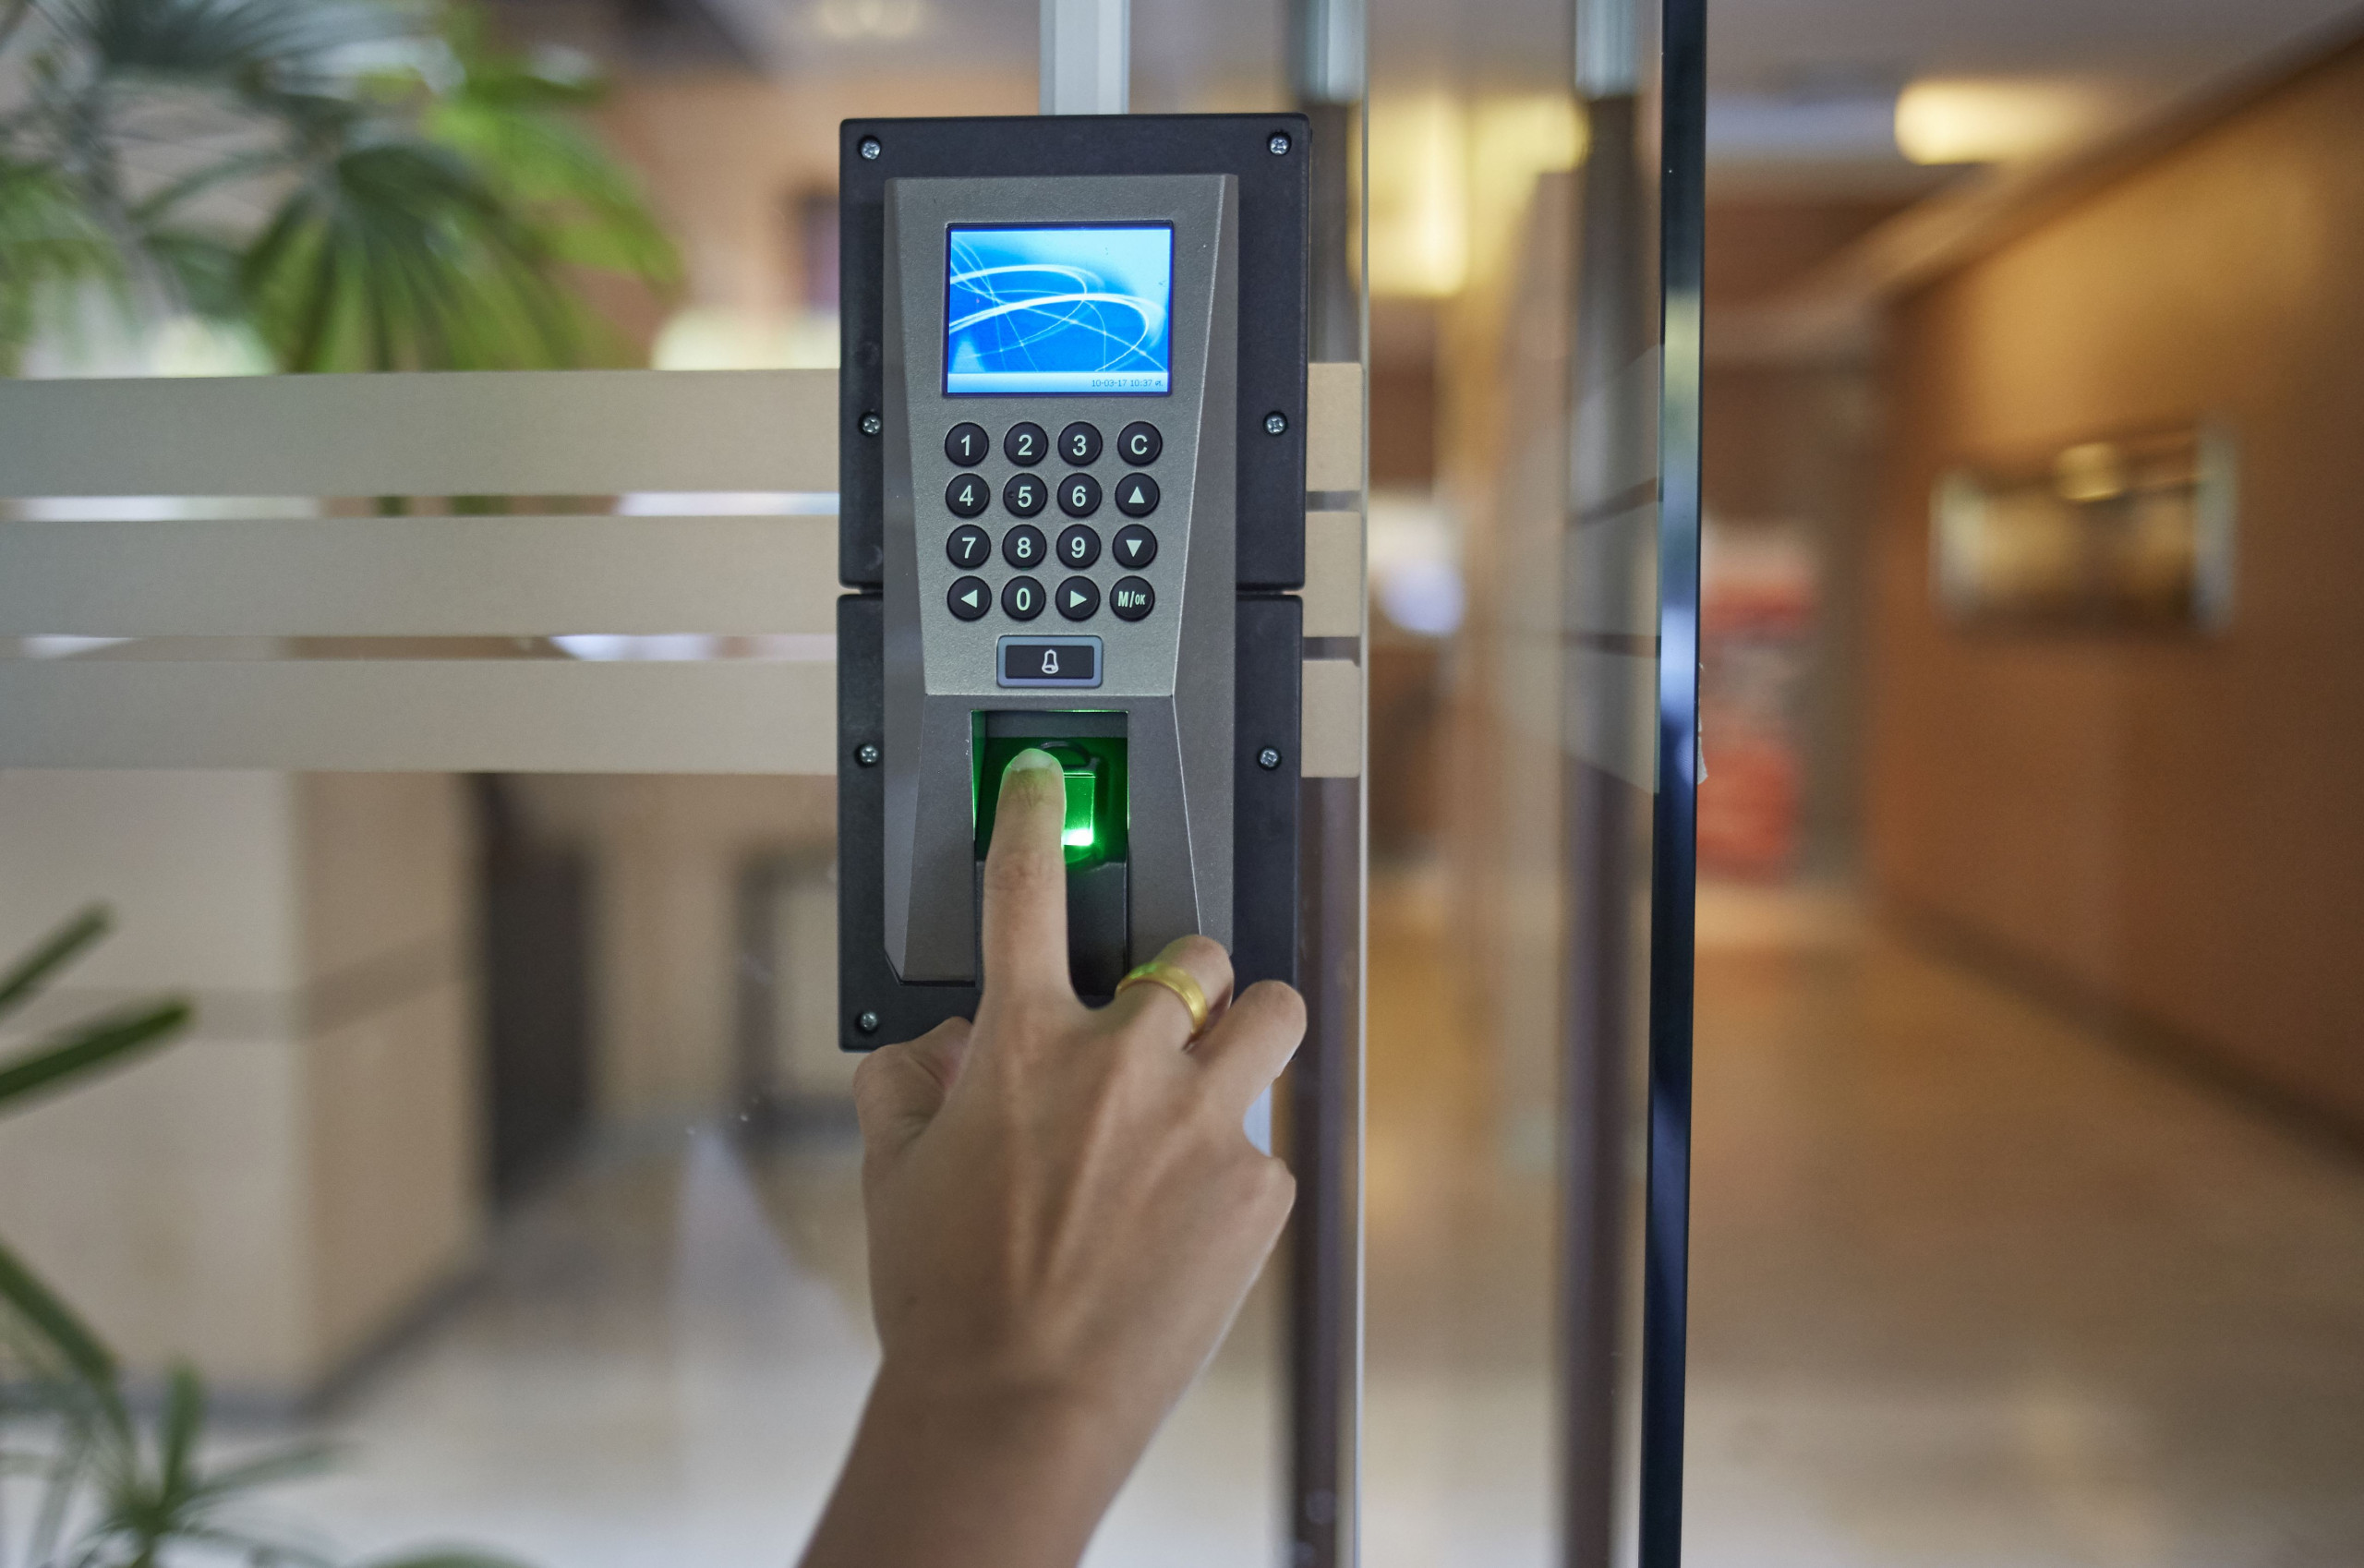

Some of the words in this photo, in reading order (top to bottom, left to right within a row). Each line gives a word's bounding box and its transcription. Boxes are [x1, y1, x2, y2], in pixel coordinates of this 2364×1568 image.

[961, 435, 970, 455] 1
[1019, 434, 1031, 455] 2
[1073, 435, 1086, 455] 3
[1131, 435, 1147, 454] C
[959, 485, 973, 506] 4
[1018, 487, 1031, 507] 5
[1072, 486, 1086, 507] 6
[962, 537, 976, 558] 7
[1018, 537, 1031, 558] 8
[1072, 537, 1085, 558] 9
[1017, 588, 1031, 610] 0
[1117, 590, 1146, 609] M/OK
